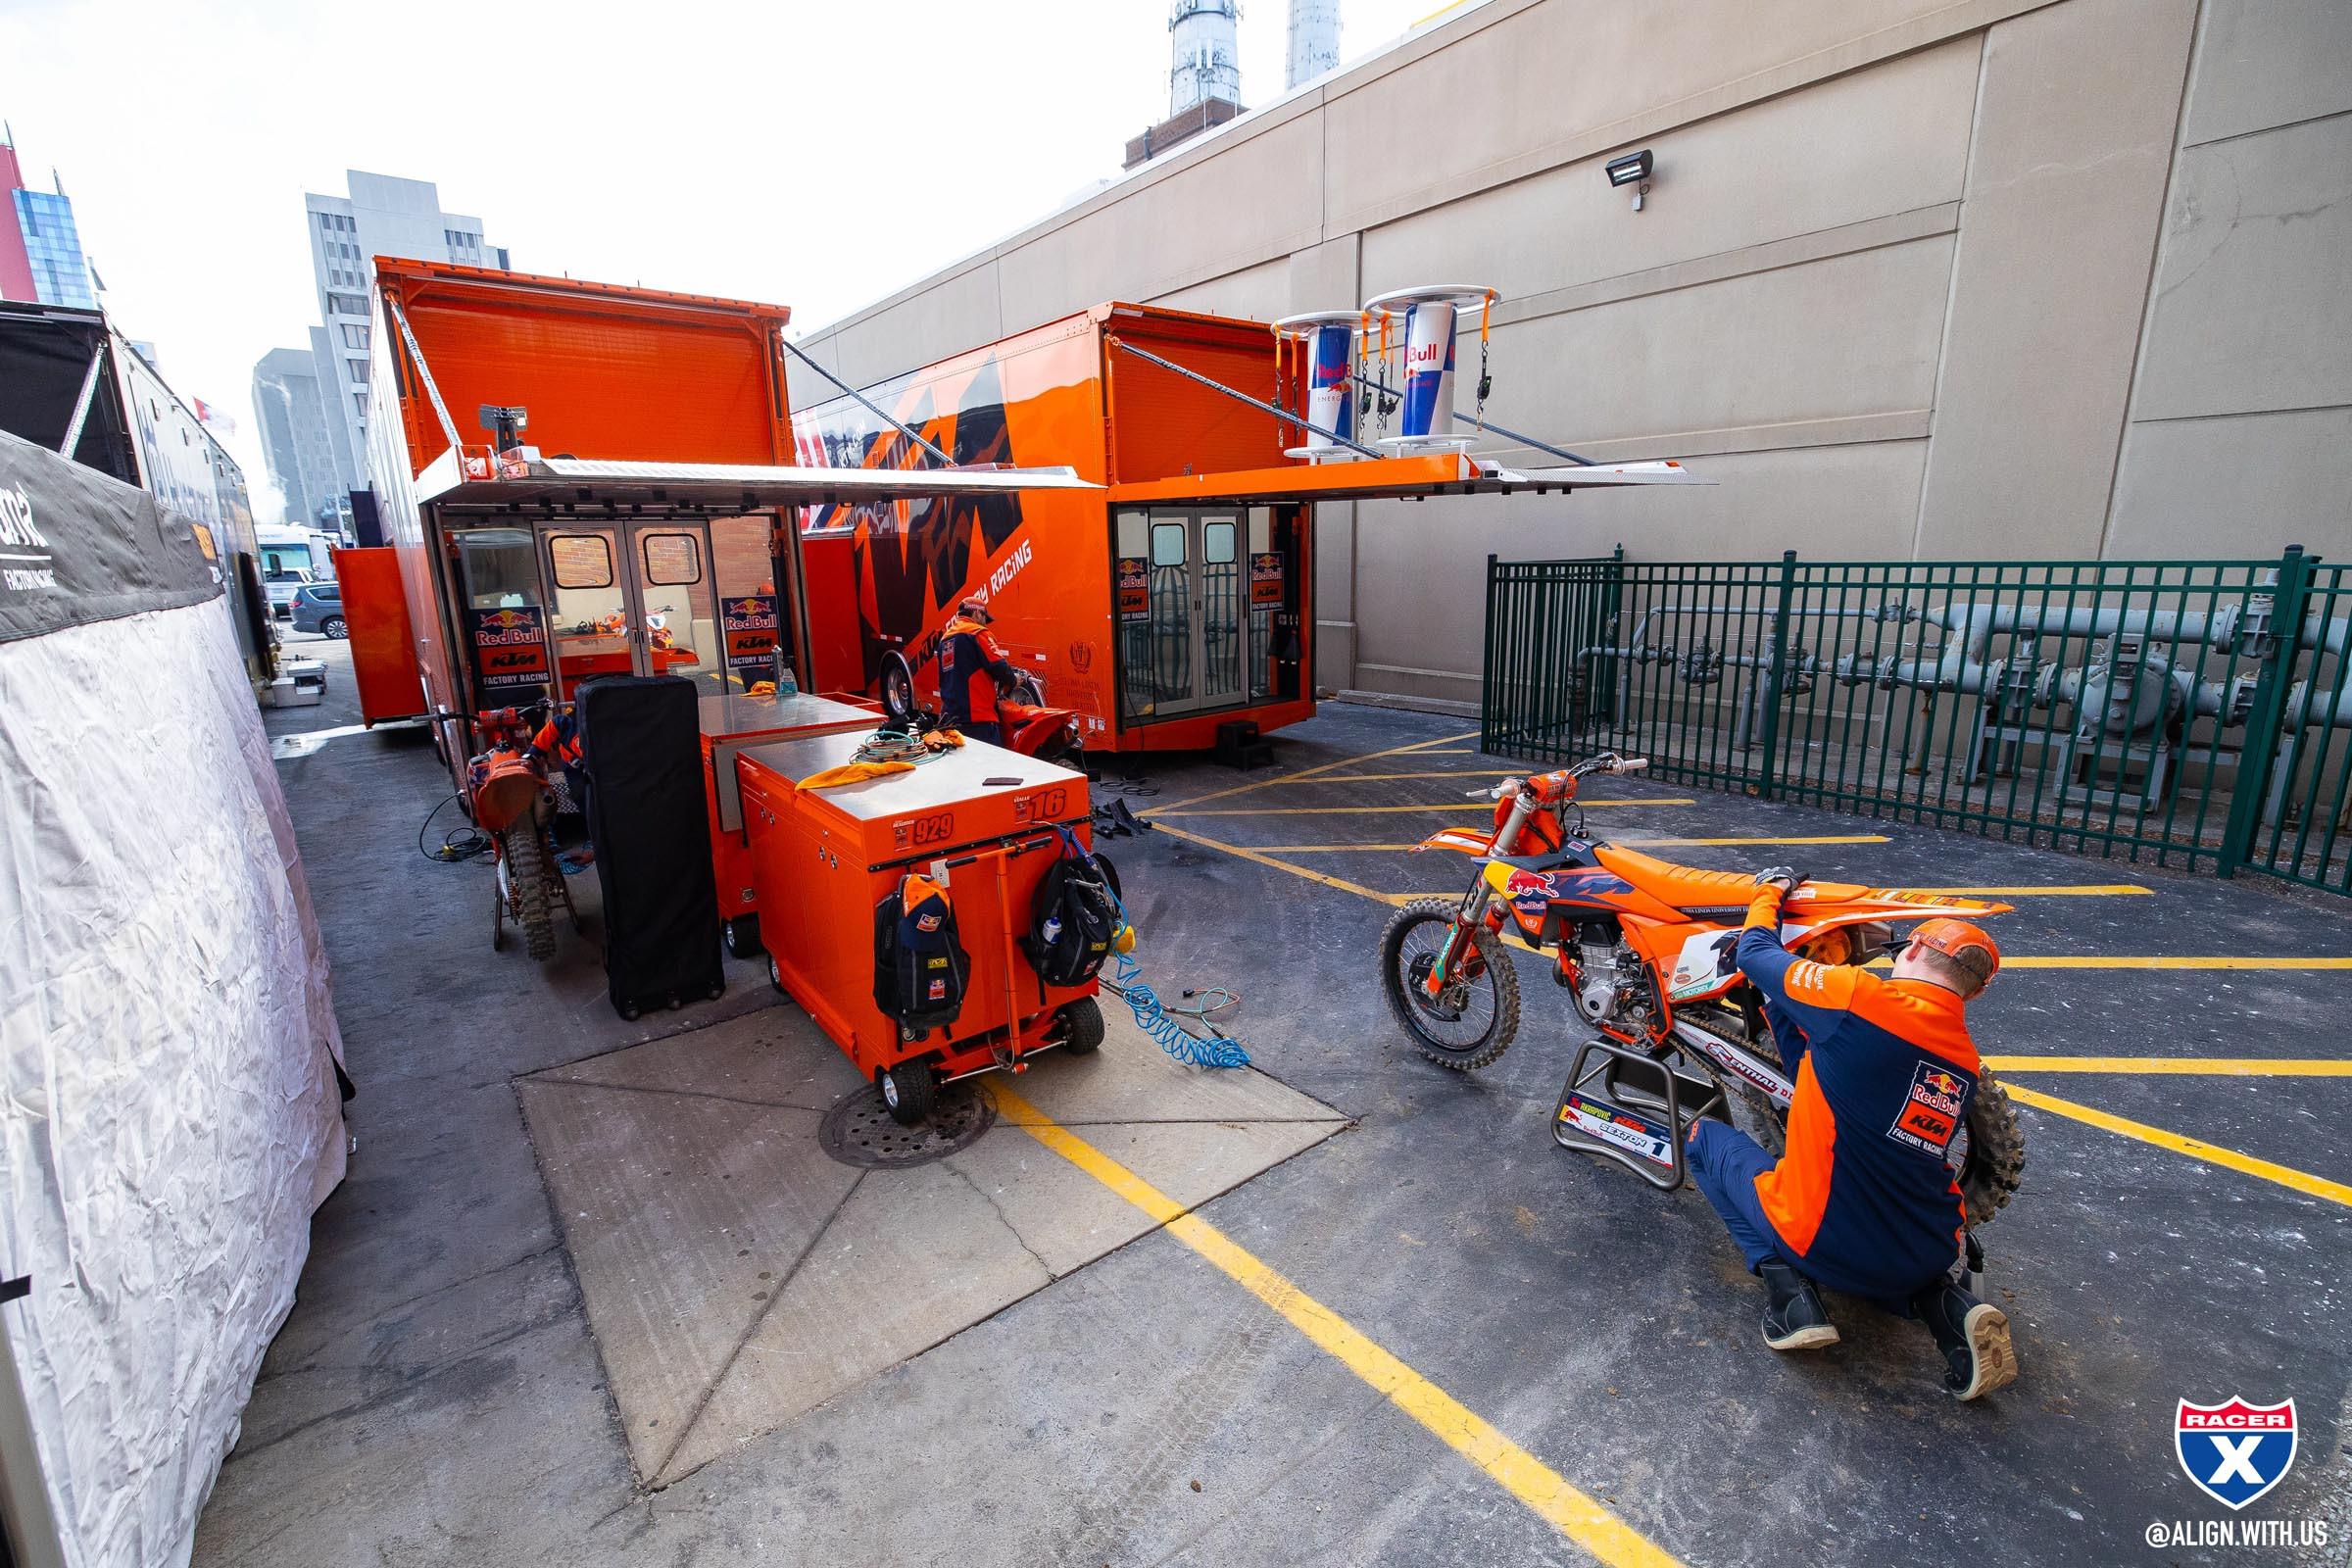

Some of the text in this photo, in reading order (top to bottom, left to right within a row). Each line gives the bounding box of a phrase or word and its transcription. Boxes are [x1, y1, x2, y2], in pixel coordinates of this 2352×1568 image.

[1317, 362, 1344, 378] Red
[1128, 574, 1148, 587] Bull
[726, 614, 777, 630] Red Bull
[475, 627, 543, 646] Red Bull
[737, 635, 772, 650] KTM
[490, 652, 538, 668] KTM
[730, 656, 758, 665] FACTORY
[483, 672, 549, 685] FACTORY RACING
[1029, 788, 1066, 821] 16
[914, 812, 955, 845] 929
[1681, 983, 1710, 999] MOTOREX
[1705, 1042, 1778, 1095] RENTHAL
[1912, 1083, 1961, 1117] Red Bull
[1612, 1115, 1646, 1134] KTM
[1909, 1114, 1948, 1137] KTM
[1599, 1122, 1647, 1148] SEXTON
[1891, 1127, 1923, 1148] FACTORY
[1652, 1141, 1666, 1157] 1
